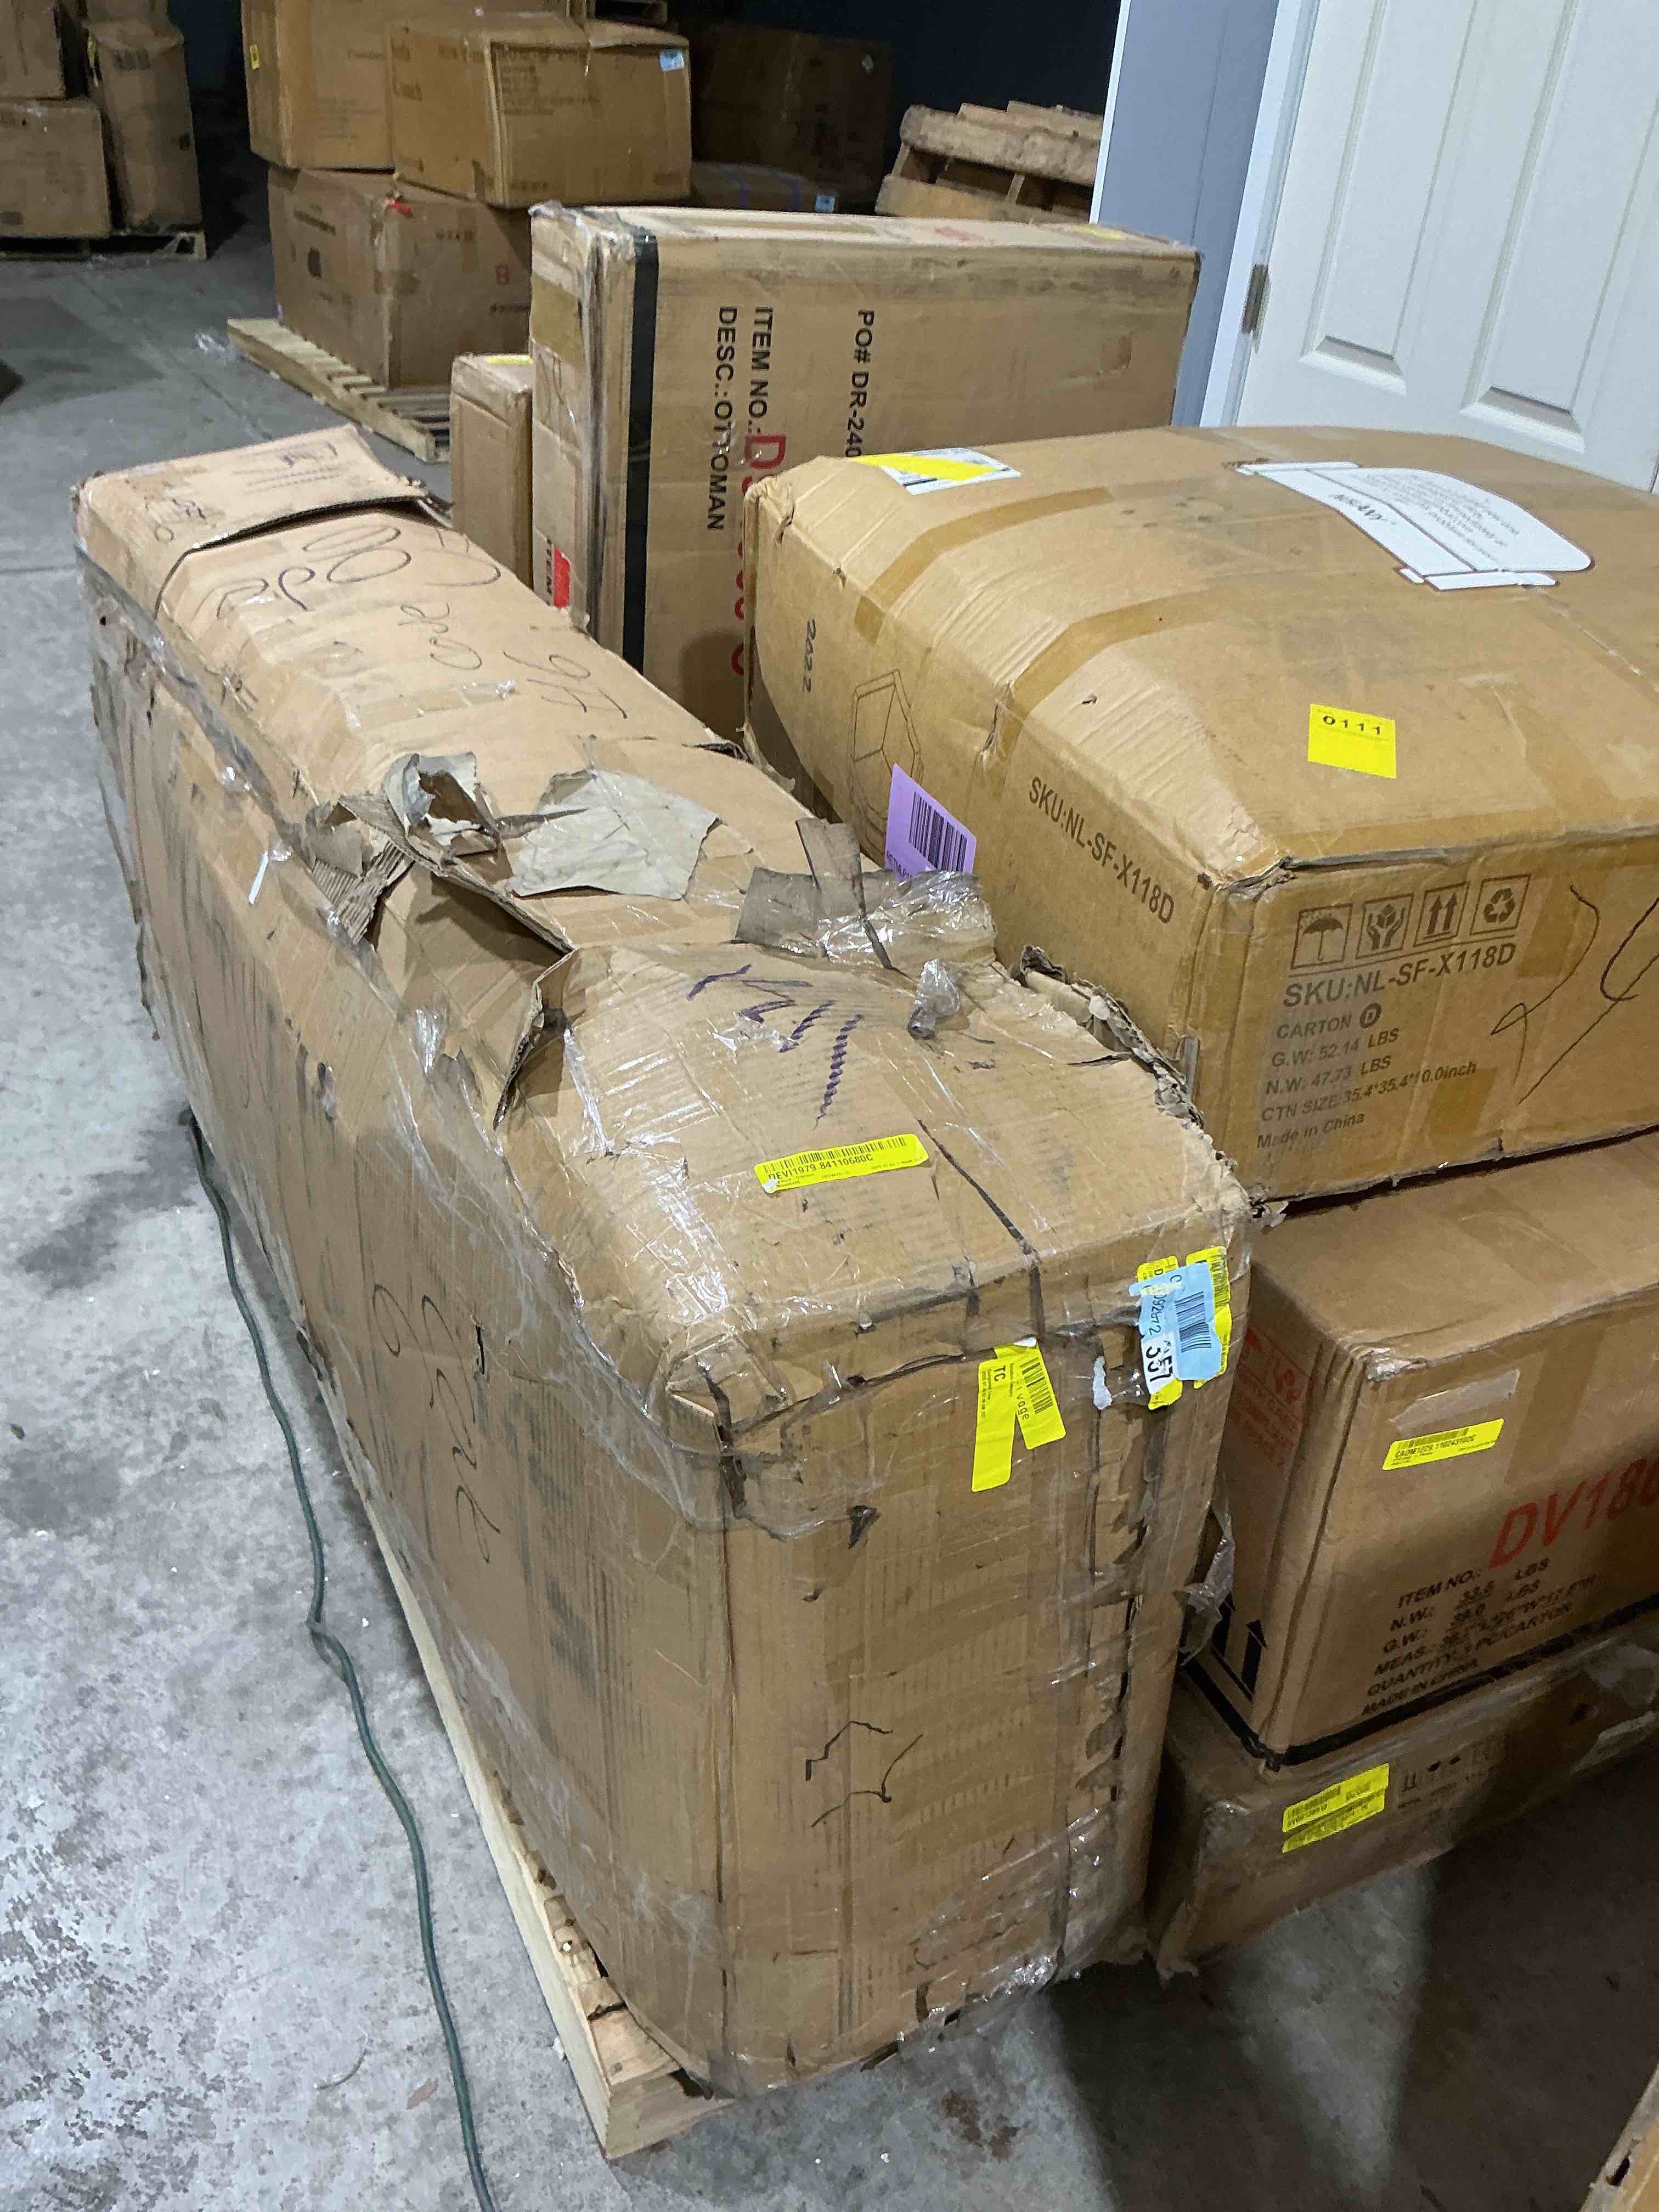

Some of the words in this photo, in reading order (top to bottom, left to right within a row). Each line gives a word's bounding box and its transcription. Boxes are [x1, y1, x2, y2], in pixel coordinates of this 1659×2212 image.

[752, 307, 774, 370] ITEM
[854, 309, 875, 363] PO#
[1322, 714, 1381, 736] 0111
[1029, 776, 1175, 924] SKU:NL-SF-X118D
[1283, 943, 1517, 1007] SKU:NL-SF-X118D
[1276, 1014, 1352, 1039] CARTON
[1368, 1028, 1400, 1048] LBS
[1360, 1055, 1392, 1075] LBS
[1262, 1103, 1297, 1121] CTN
[1323, 1113, 1365, 1133] China
[994, 1365, 1006, 1381] TC
